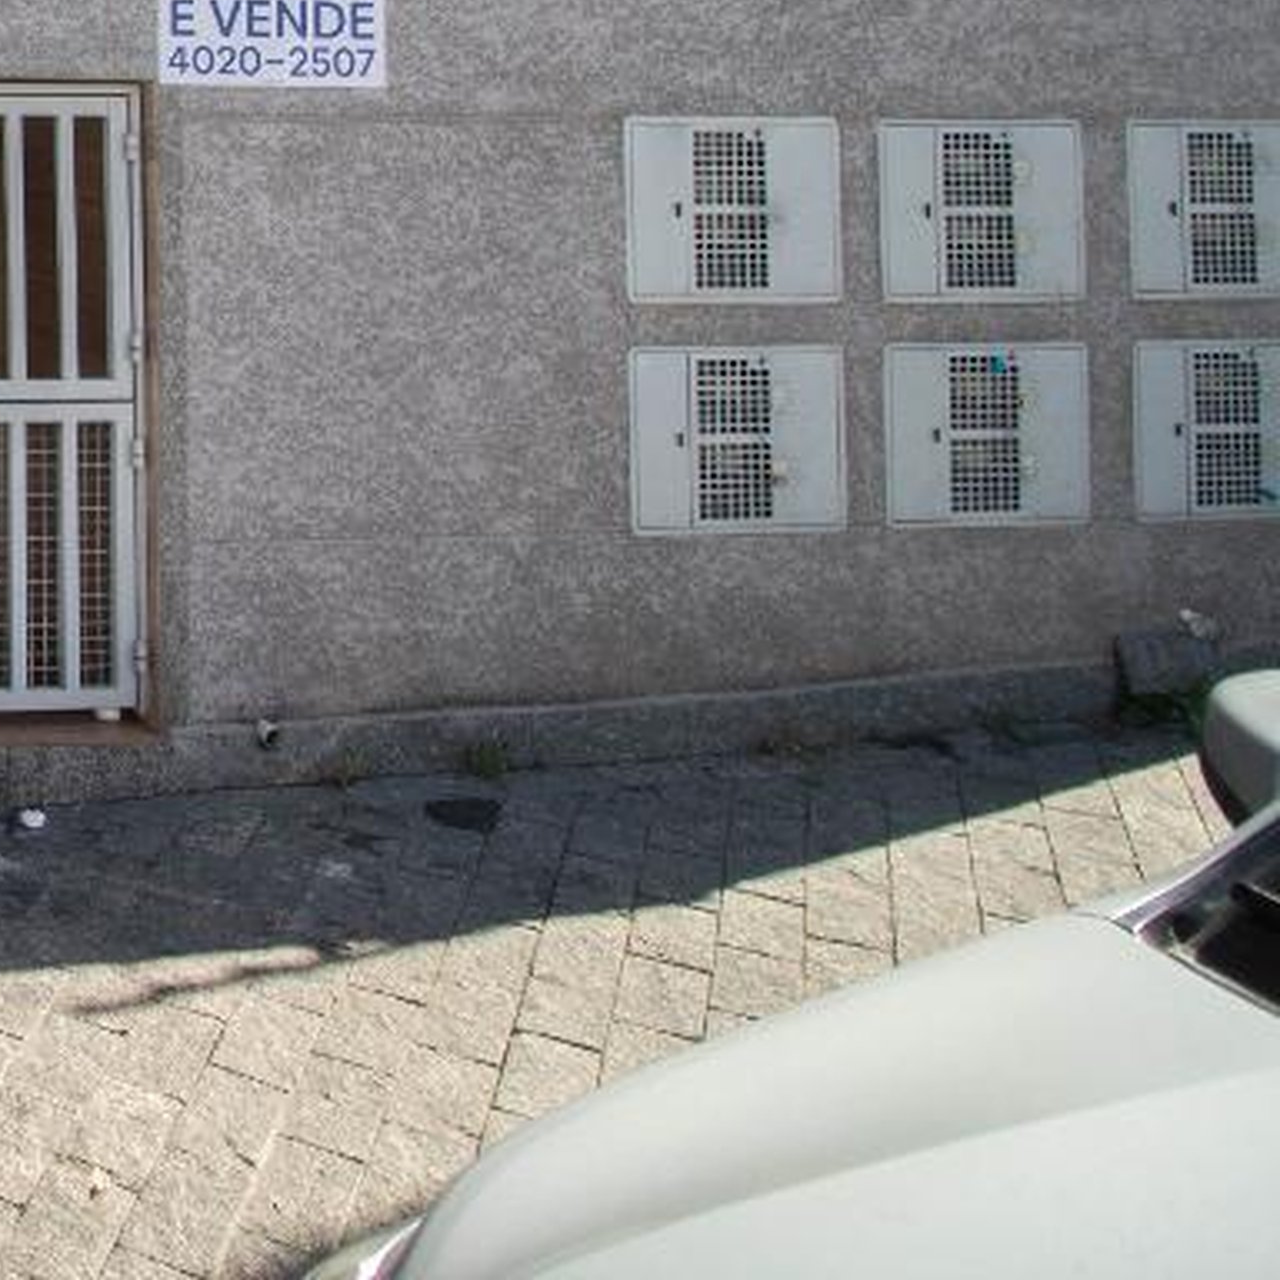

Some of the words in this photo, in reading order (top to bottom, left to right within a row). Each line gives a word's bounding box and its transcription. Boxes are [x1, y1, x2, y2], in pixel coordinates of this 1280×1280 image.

[171, 0, 195, 37] E
[210, 0, 375, 39] VENDE
[167, 45, 375, 77] 4020-2507
